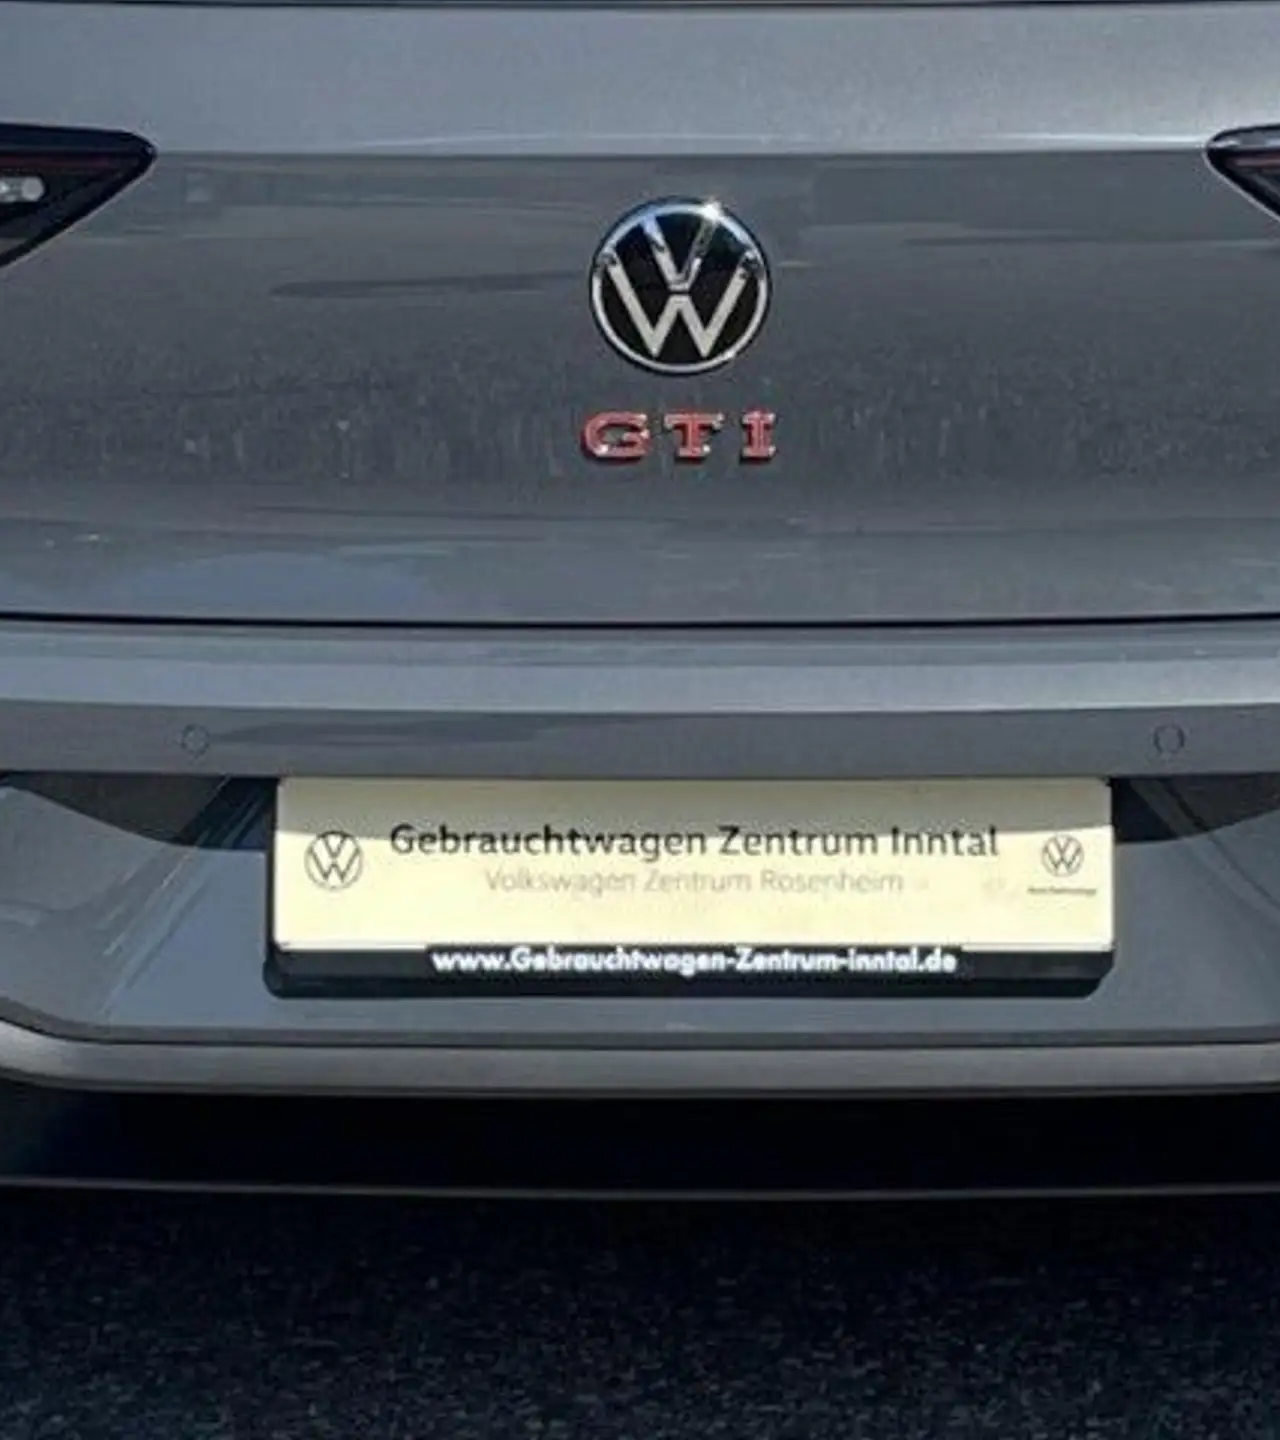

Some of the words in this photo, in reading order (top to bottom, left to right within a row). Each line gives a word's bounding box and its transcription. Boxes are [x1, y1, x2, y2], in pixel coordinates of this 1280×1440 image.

[581, 409, 778, 464] GTI
[390, 823, 708, 862] Gebrauchtwagen
[718, 824, 880, 858] Zentrum
[891, 825, 1001, 858] Inntal
[485, 866, 636, 896] Volkswagen
[643, 869, 752, 894] Zentrum
[760, 867, 905, 894] Rosenheim
